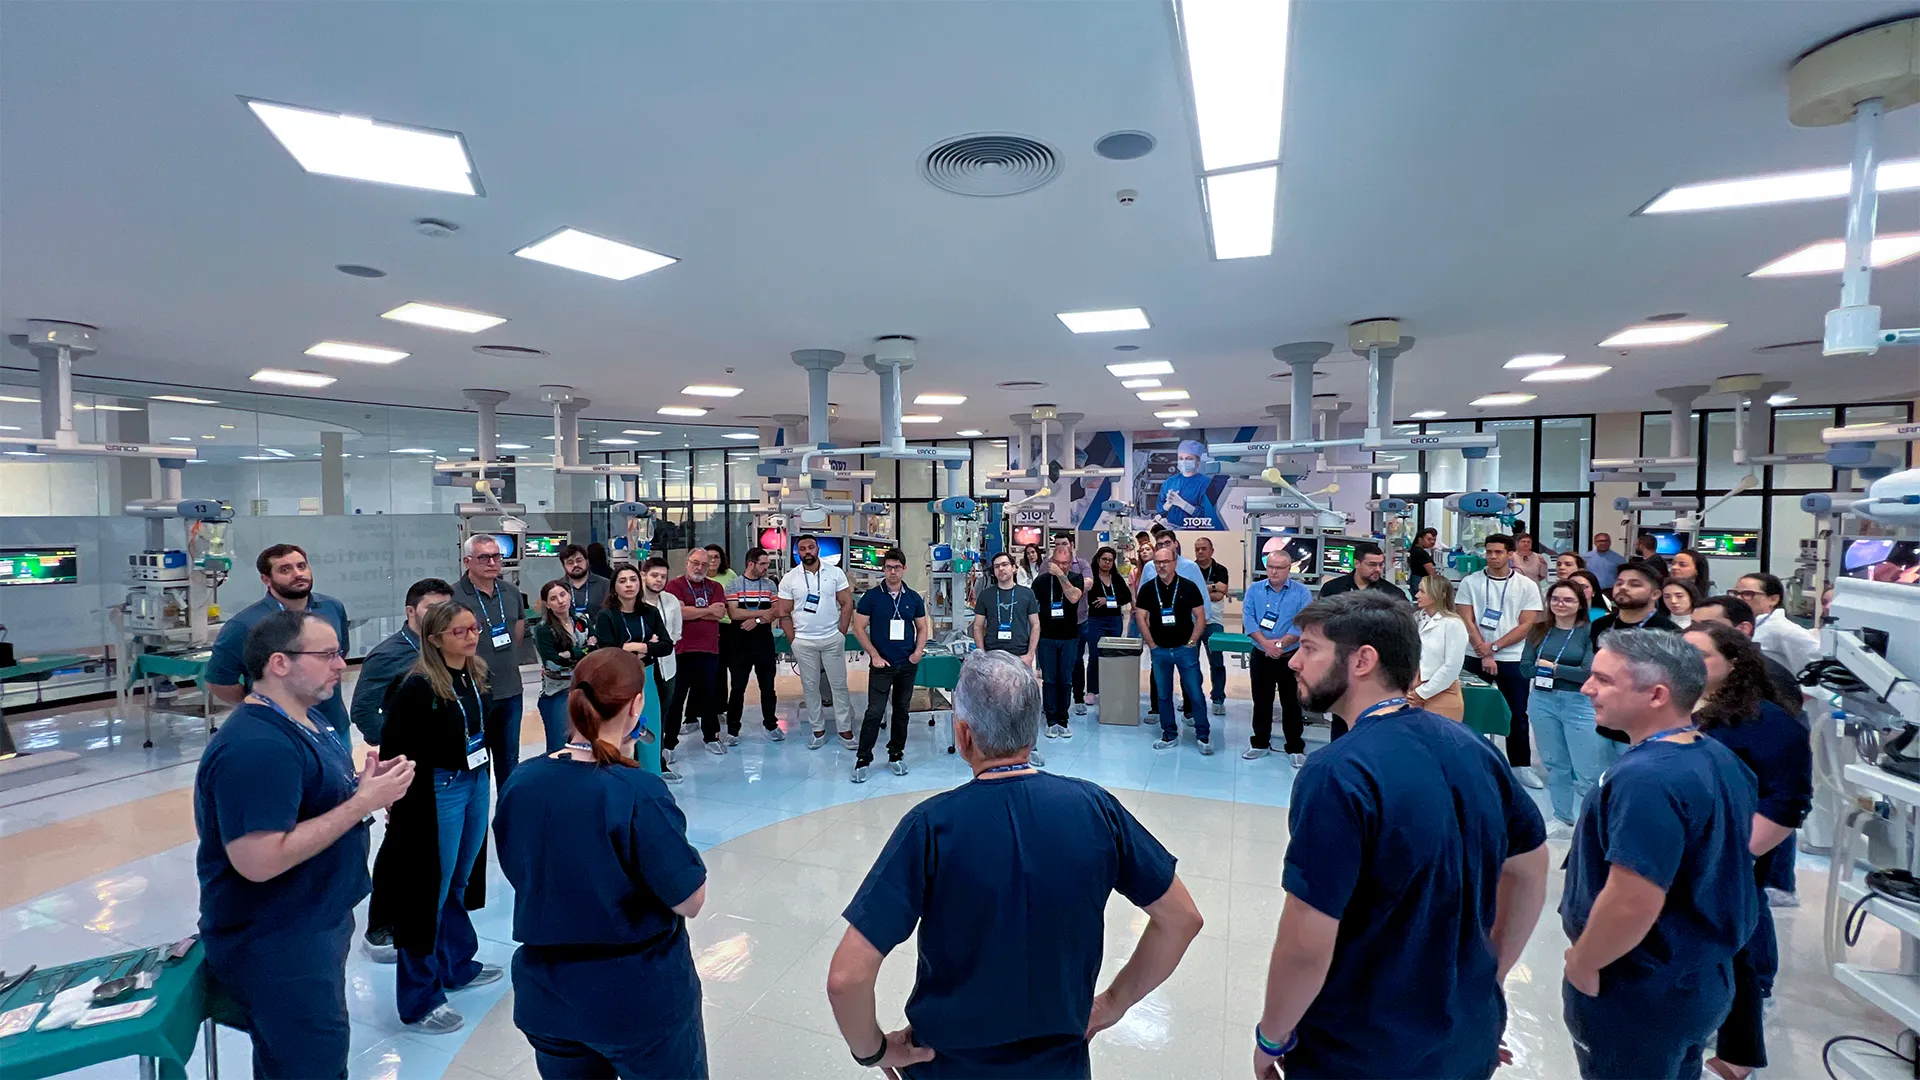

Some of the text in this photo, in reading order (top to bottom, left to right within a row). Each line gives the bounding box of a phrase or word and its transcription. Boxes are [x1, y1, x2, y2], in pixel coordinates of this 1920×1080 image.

[955, 501, 965, 510] 04
[1475, 498, 1490, 508] 03
[194, 504, 208, 514] 13
[1183, 517, 1212, 527] STORZ
